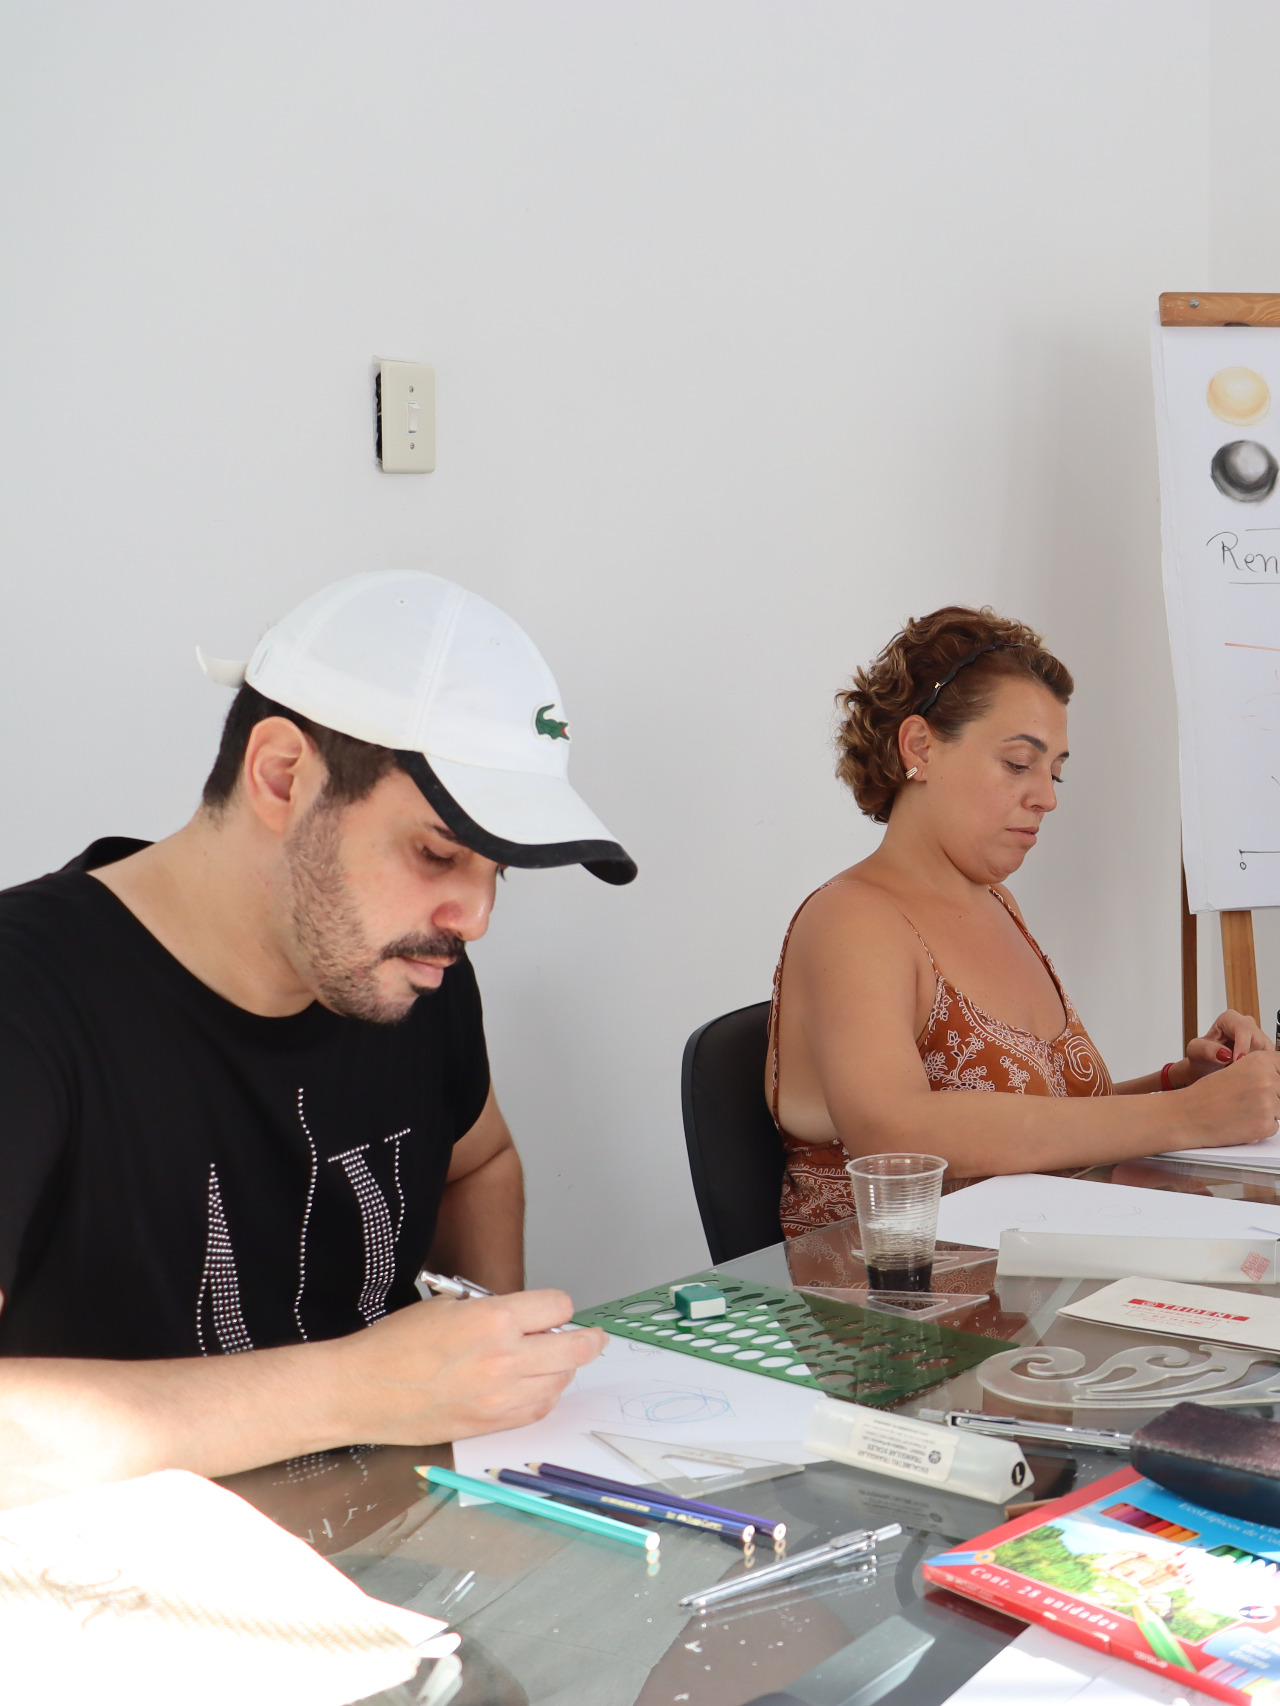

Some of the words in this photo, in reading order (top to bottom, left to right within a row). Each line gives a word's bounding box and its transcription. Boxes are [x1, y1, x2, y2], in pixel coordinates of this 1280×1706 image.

[1163, 1302, 1239, 1319] TRIDENT
[1242, 1527, 1258, 1537] de
[969, 1566, 1012, 1590] Cont.
[1016, 1584, 1041, 1599] 28
[1042, 1595, 1120, 1631] unidades
